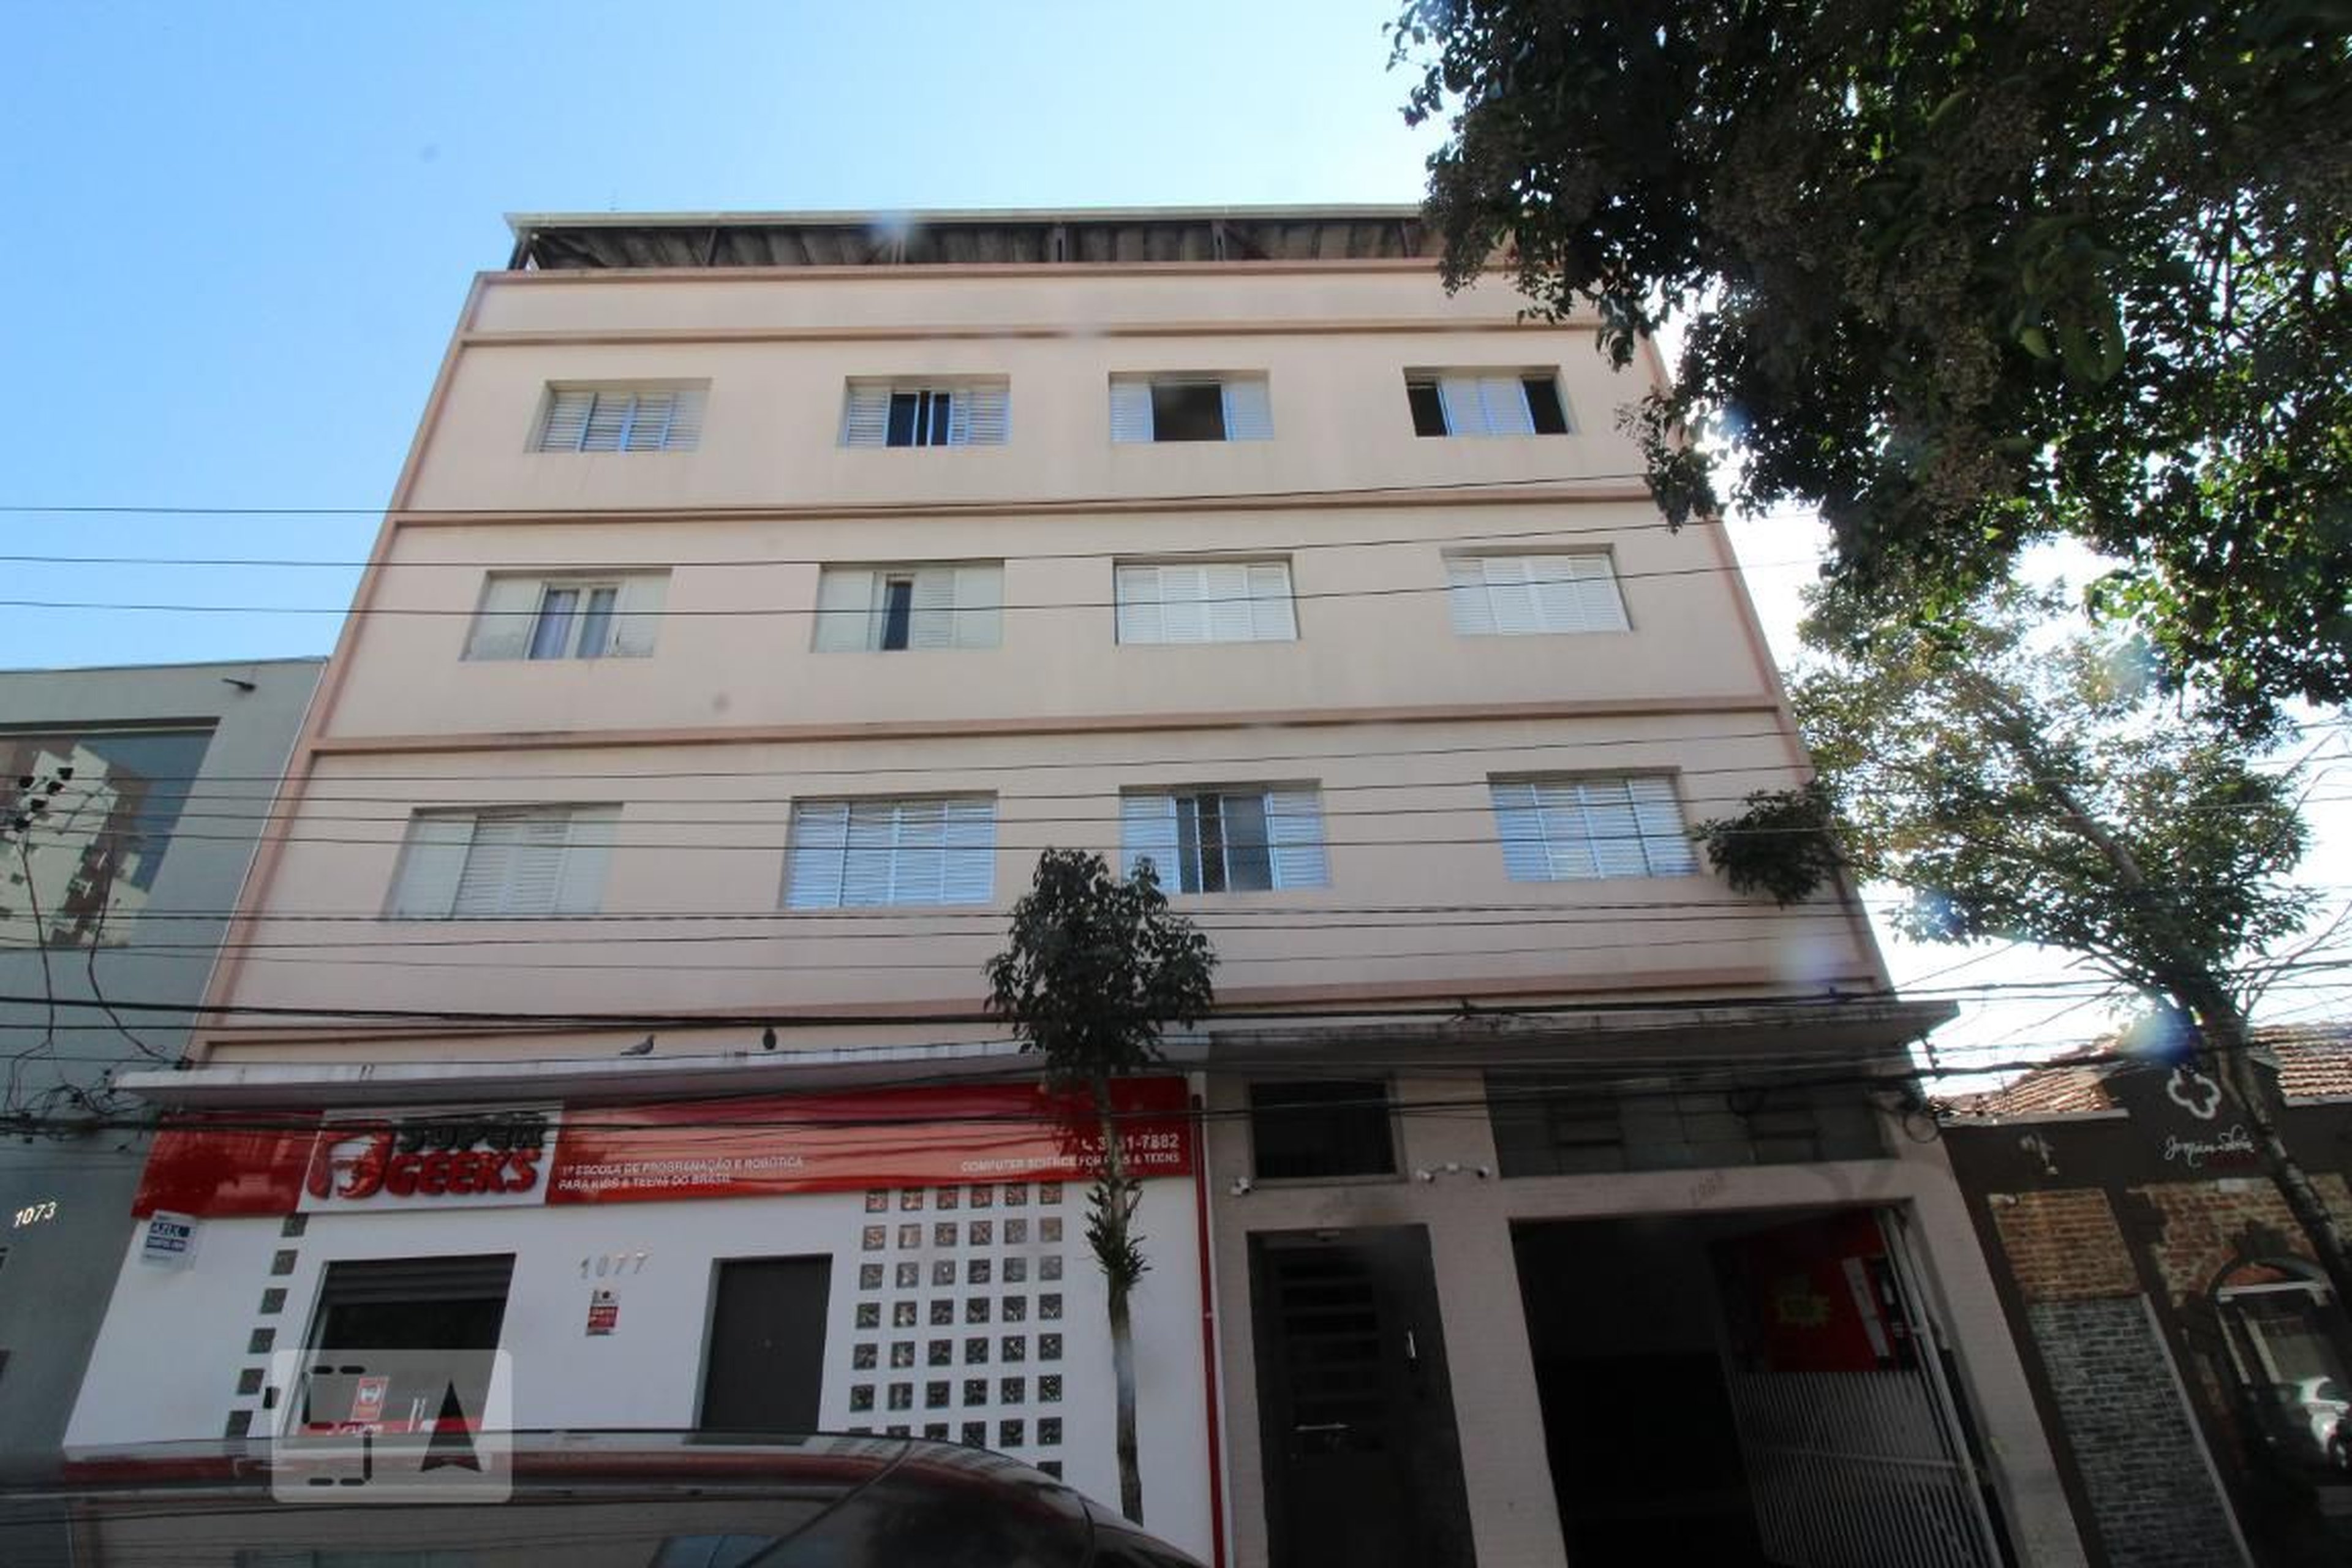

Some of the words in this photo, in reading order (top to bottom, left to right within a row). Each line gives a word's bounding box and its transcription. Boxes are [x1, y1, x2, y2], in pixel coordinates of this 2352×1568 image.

[385, 1147, 541, 1196] GEEKS
[575, 1164, 621, 1175] ESCOLA
[962, 1159, 1025, 1172] COMPUTER
[1027, 1154, 1077, 1169] SCIENCE
[1144, 1150, 1181, 1164] TEENS
[559, 1178, 589, 1190] PARA
[13, 1200, 57, 1229] 1073
[580, 1252, 649, 1280] 1077
